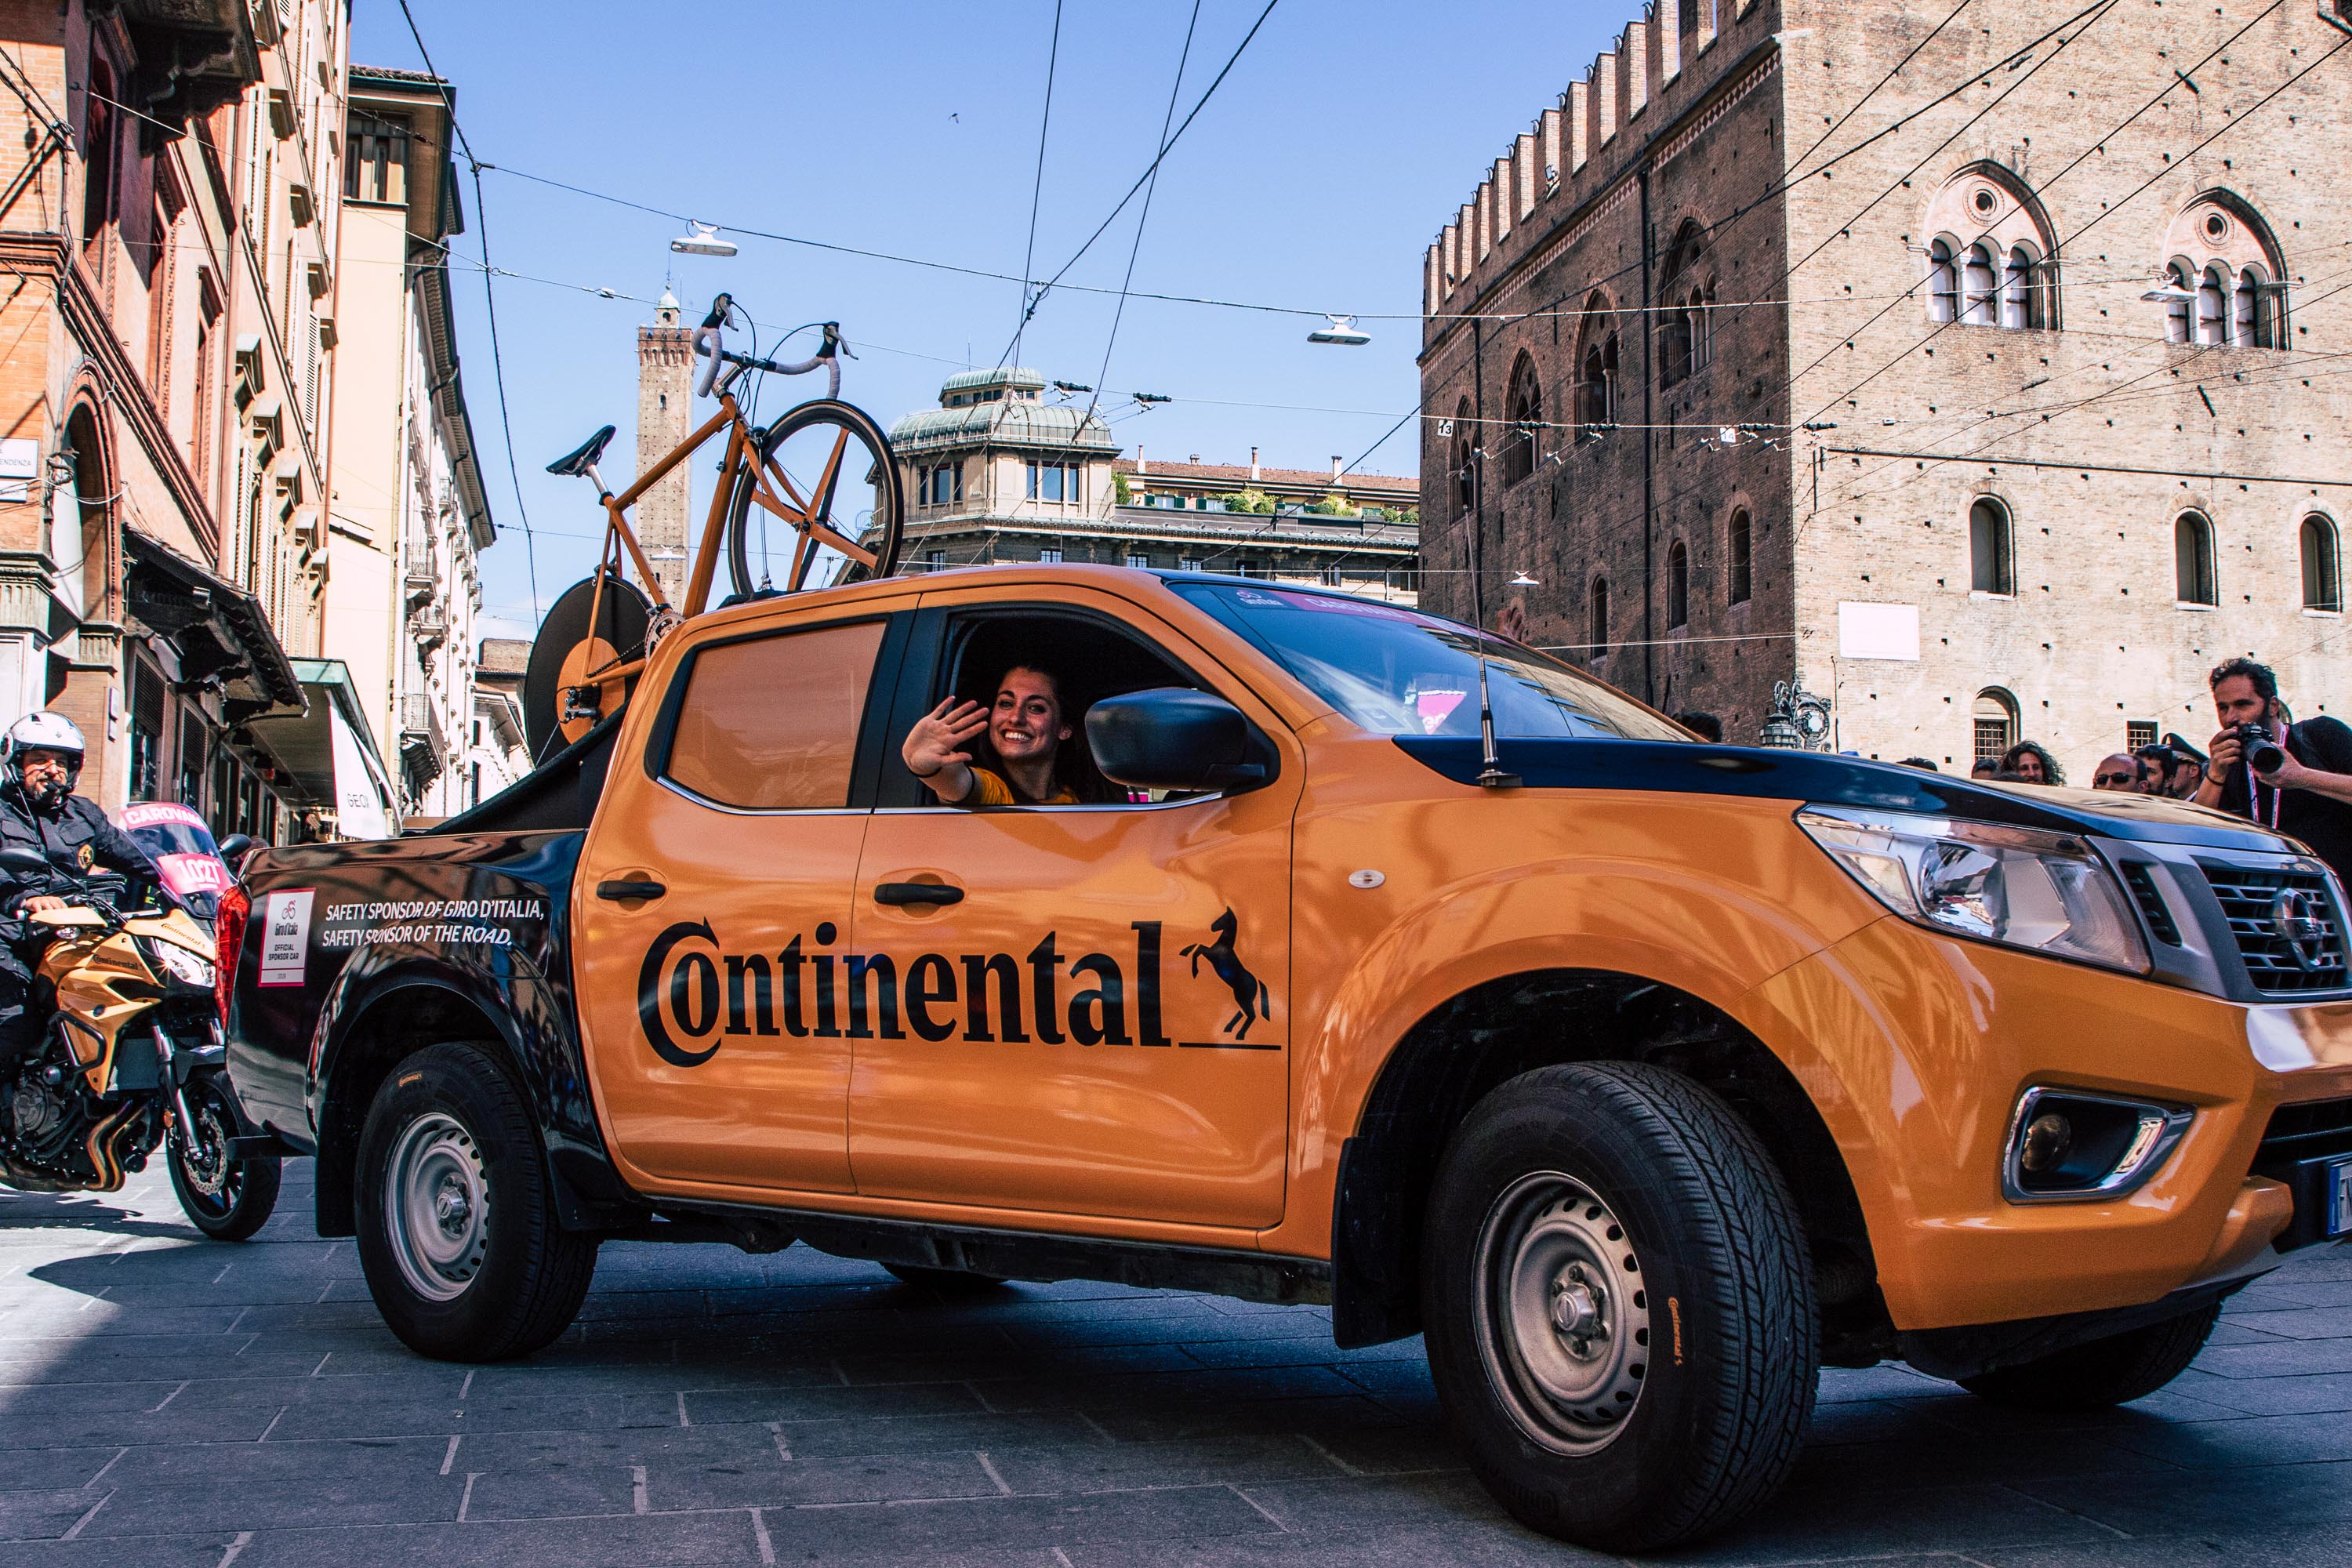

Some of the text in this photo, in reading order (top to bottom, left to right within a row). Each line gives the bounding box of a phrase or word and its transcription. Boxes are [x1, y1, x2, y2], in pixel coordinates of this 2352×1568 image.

[1439, 423, 1452, 434] 13
[325, 899, 545, 921] SAFETY SPONSOR OF GIRO D'ITALIA,
[161, 923, 201, 946] Continental
[322, 924, 513, 947] SAFETY SPONSOR OF THE ROAD.
[274, 943, 295, 952] OFFICIAL
[93, 954, 139, 970] Continental
[637, 916, 1172, 1068] Continental
